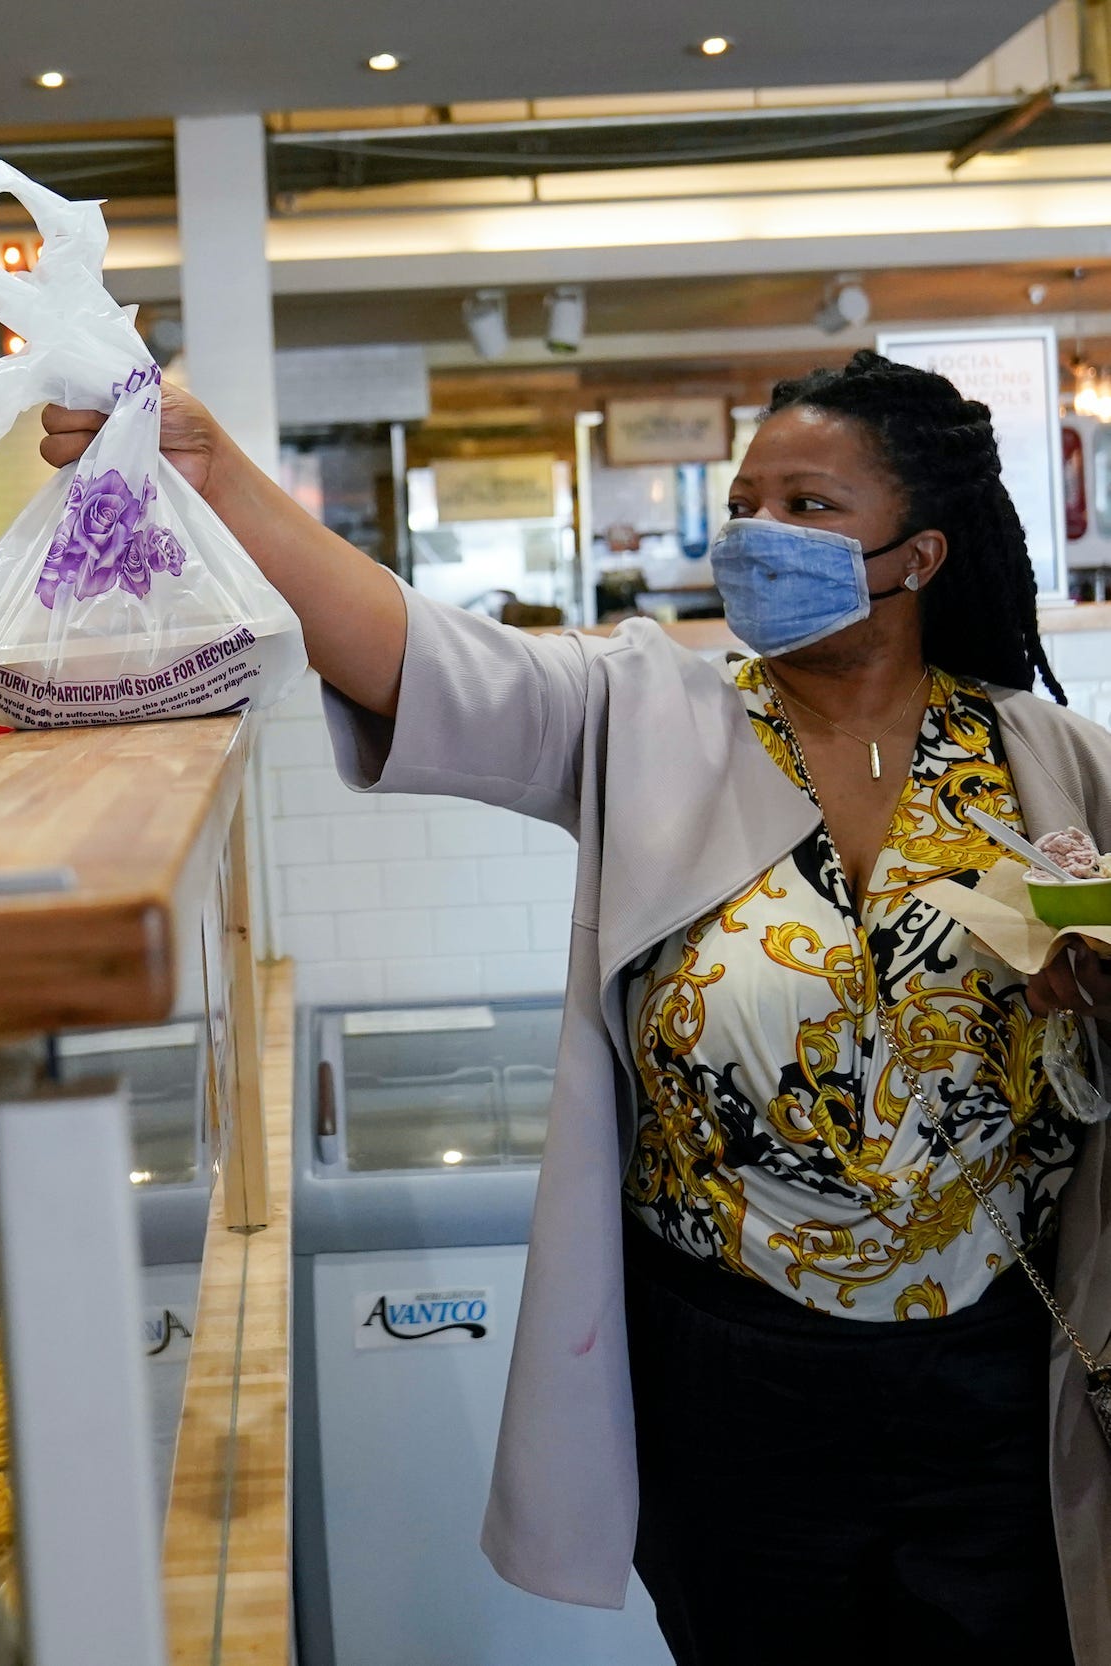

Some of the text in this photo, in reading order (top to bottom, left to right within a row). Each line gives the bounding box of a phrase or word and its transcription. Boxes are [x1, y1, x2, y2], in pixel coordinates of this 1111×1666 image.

[32, 683, 44, 700] TO
[51, 678, 134, 702] PARTICIPATING
[135, 671, 173, 697] STORE
[173, 658, 198, 683] FOR
[195, 627, 256, 672] RECYCLING
[24, 715, 36, 726] Do
[170, 693, 214, 710] carriages,
[213, 686, 223, 695] or
[54, 711, 64, 719] of
[142, 701, 159, 711] this
[160, 690, 189, 707] plastic
[189, 682, 207, 696] bag
[206, 672, 228, 687] away
[227, 661, 248, 675] from
[362, 1296, 487, 1338] AVANTCO
